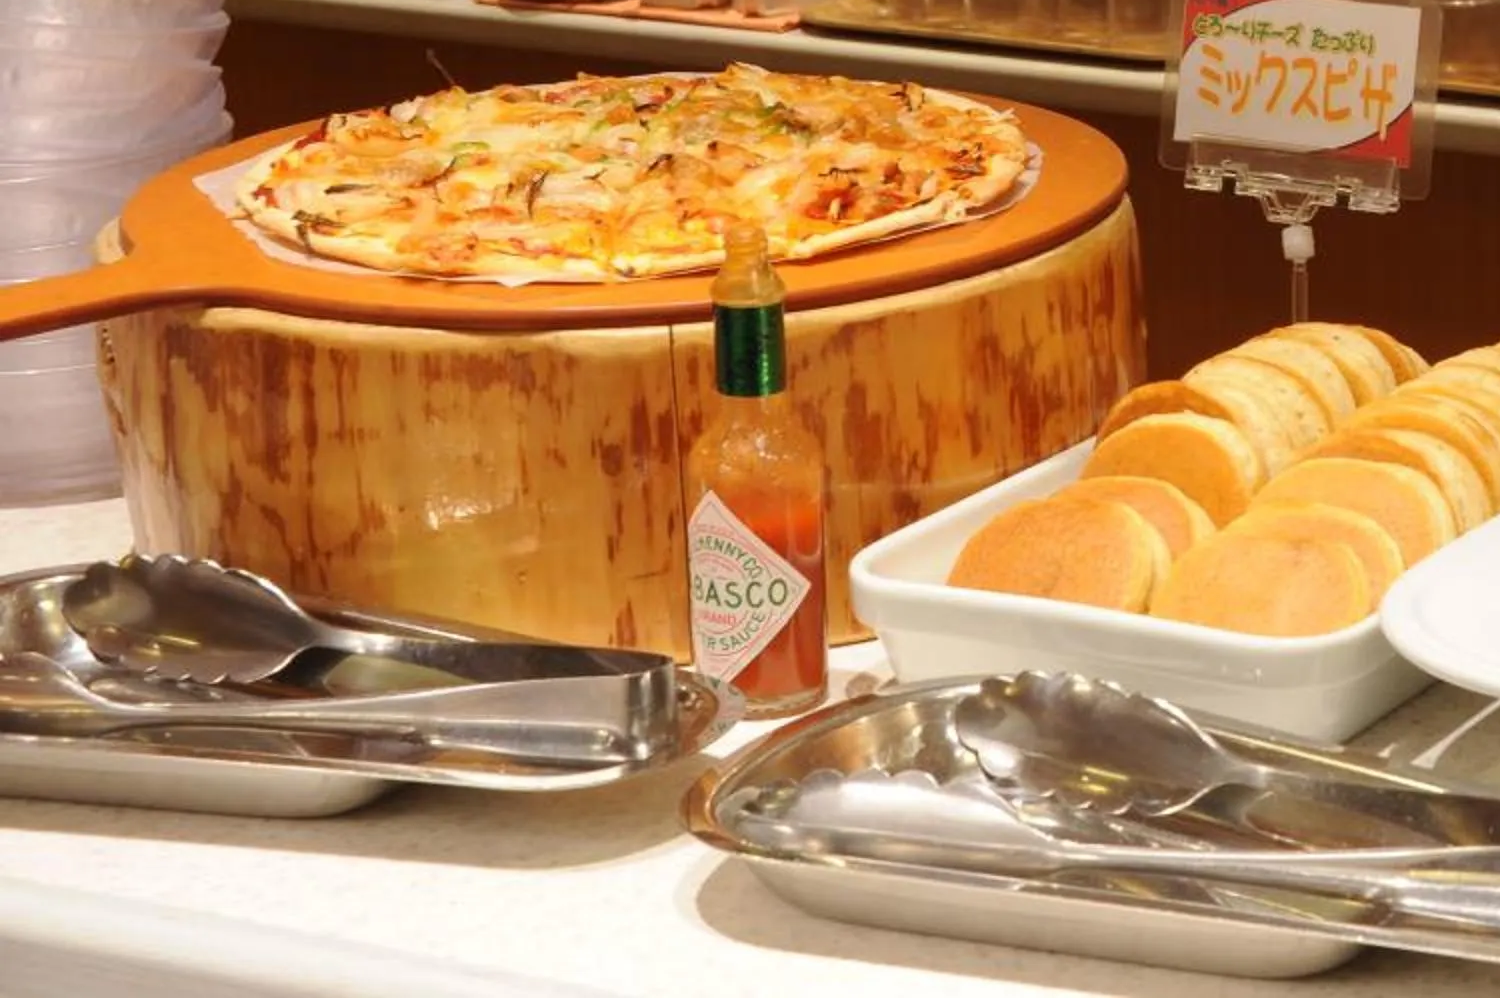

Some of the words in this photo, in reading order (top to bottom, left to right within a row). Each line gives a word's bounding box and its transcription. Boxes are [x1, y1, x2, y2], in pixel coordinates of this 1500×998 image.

[1196, 42, 1398, 142] ミックスピザ
[718, 612, 766, 651] SAUCE
